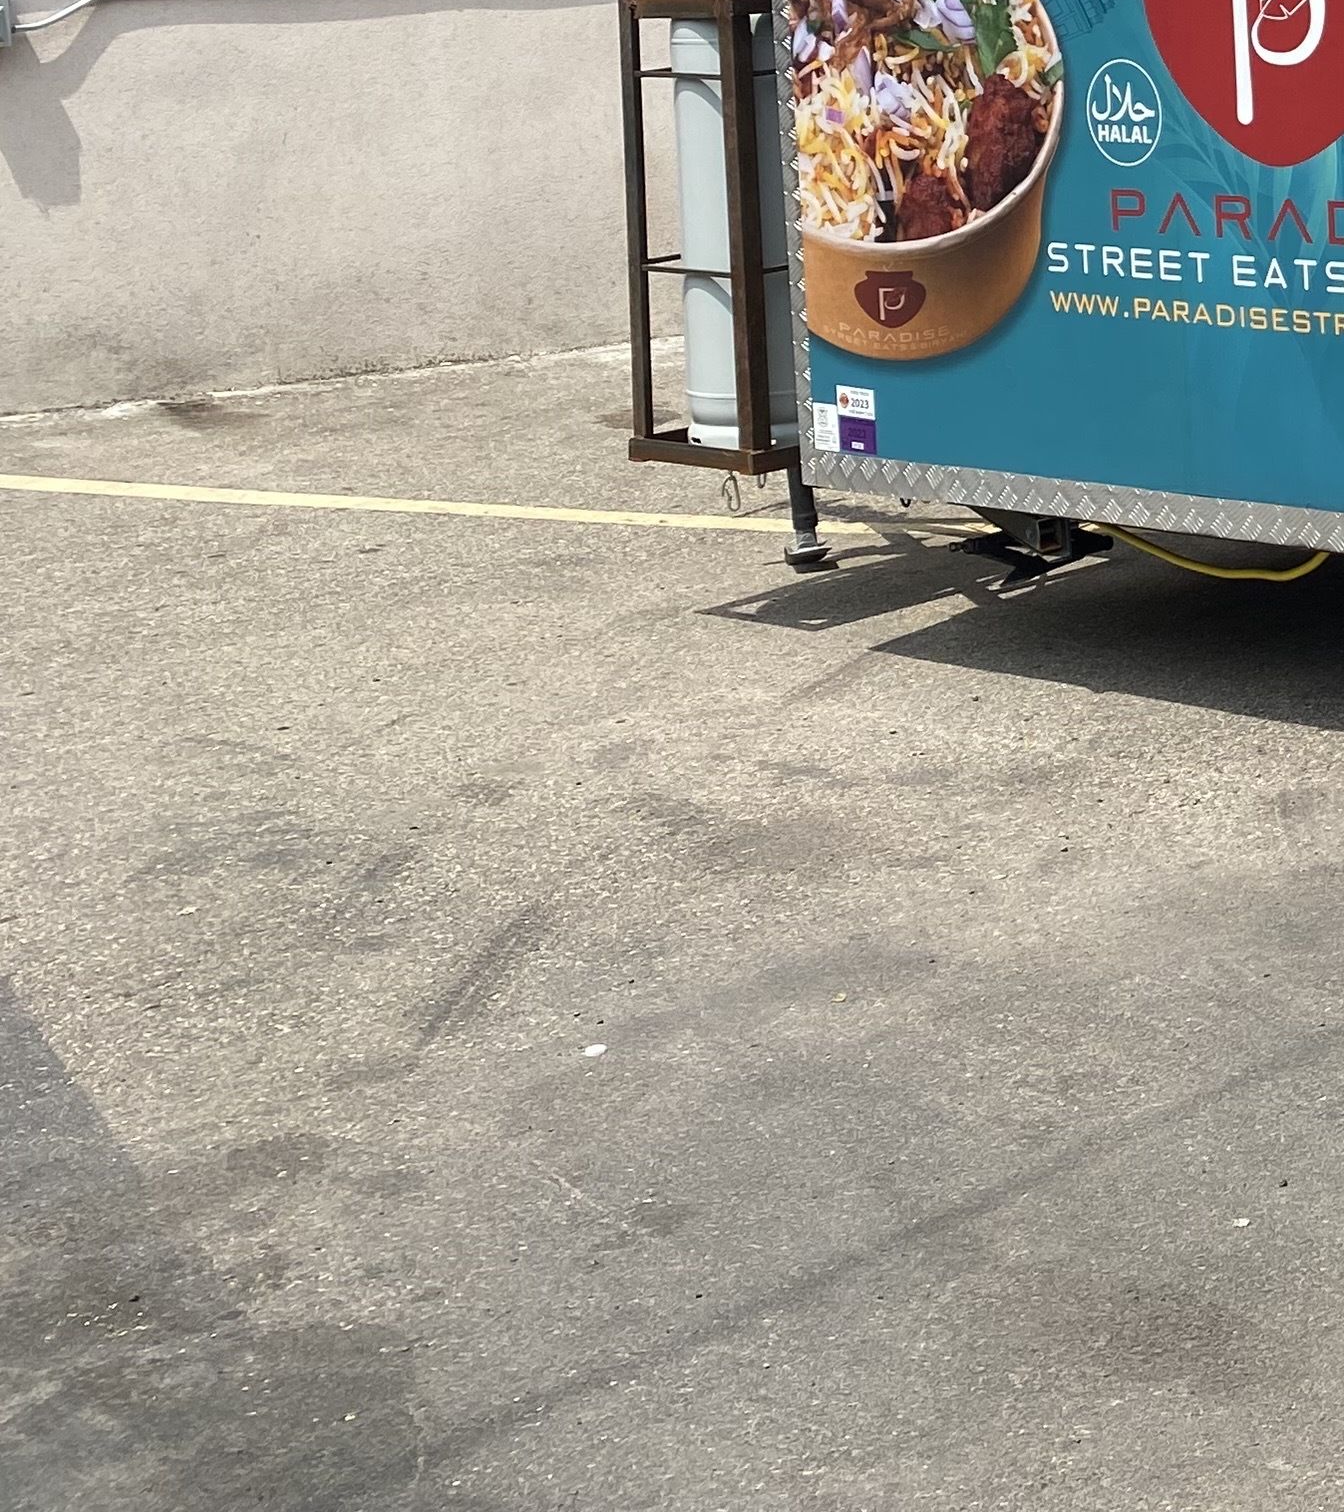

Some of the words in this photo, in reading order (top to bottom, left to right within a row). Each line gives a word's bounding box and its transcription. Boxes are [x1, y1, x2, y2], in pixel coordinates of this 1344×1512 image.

[1091, 70, 1155, 122] حلال
[1097, 123, 1153, 146] HALAL
[1047, 241, 1210, 282] STREET
[839, 321, 950, 343] PARADISE
[851, 398, 870, 409] 2023
